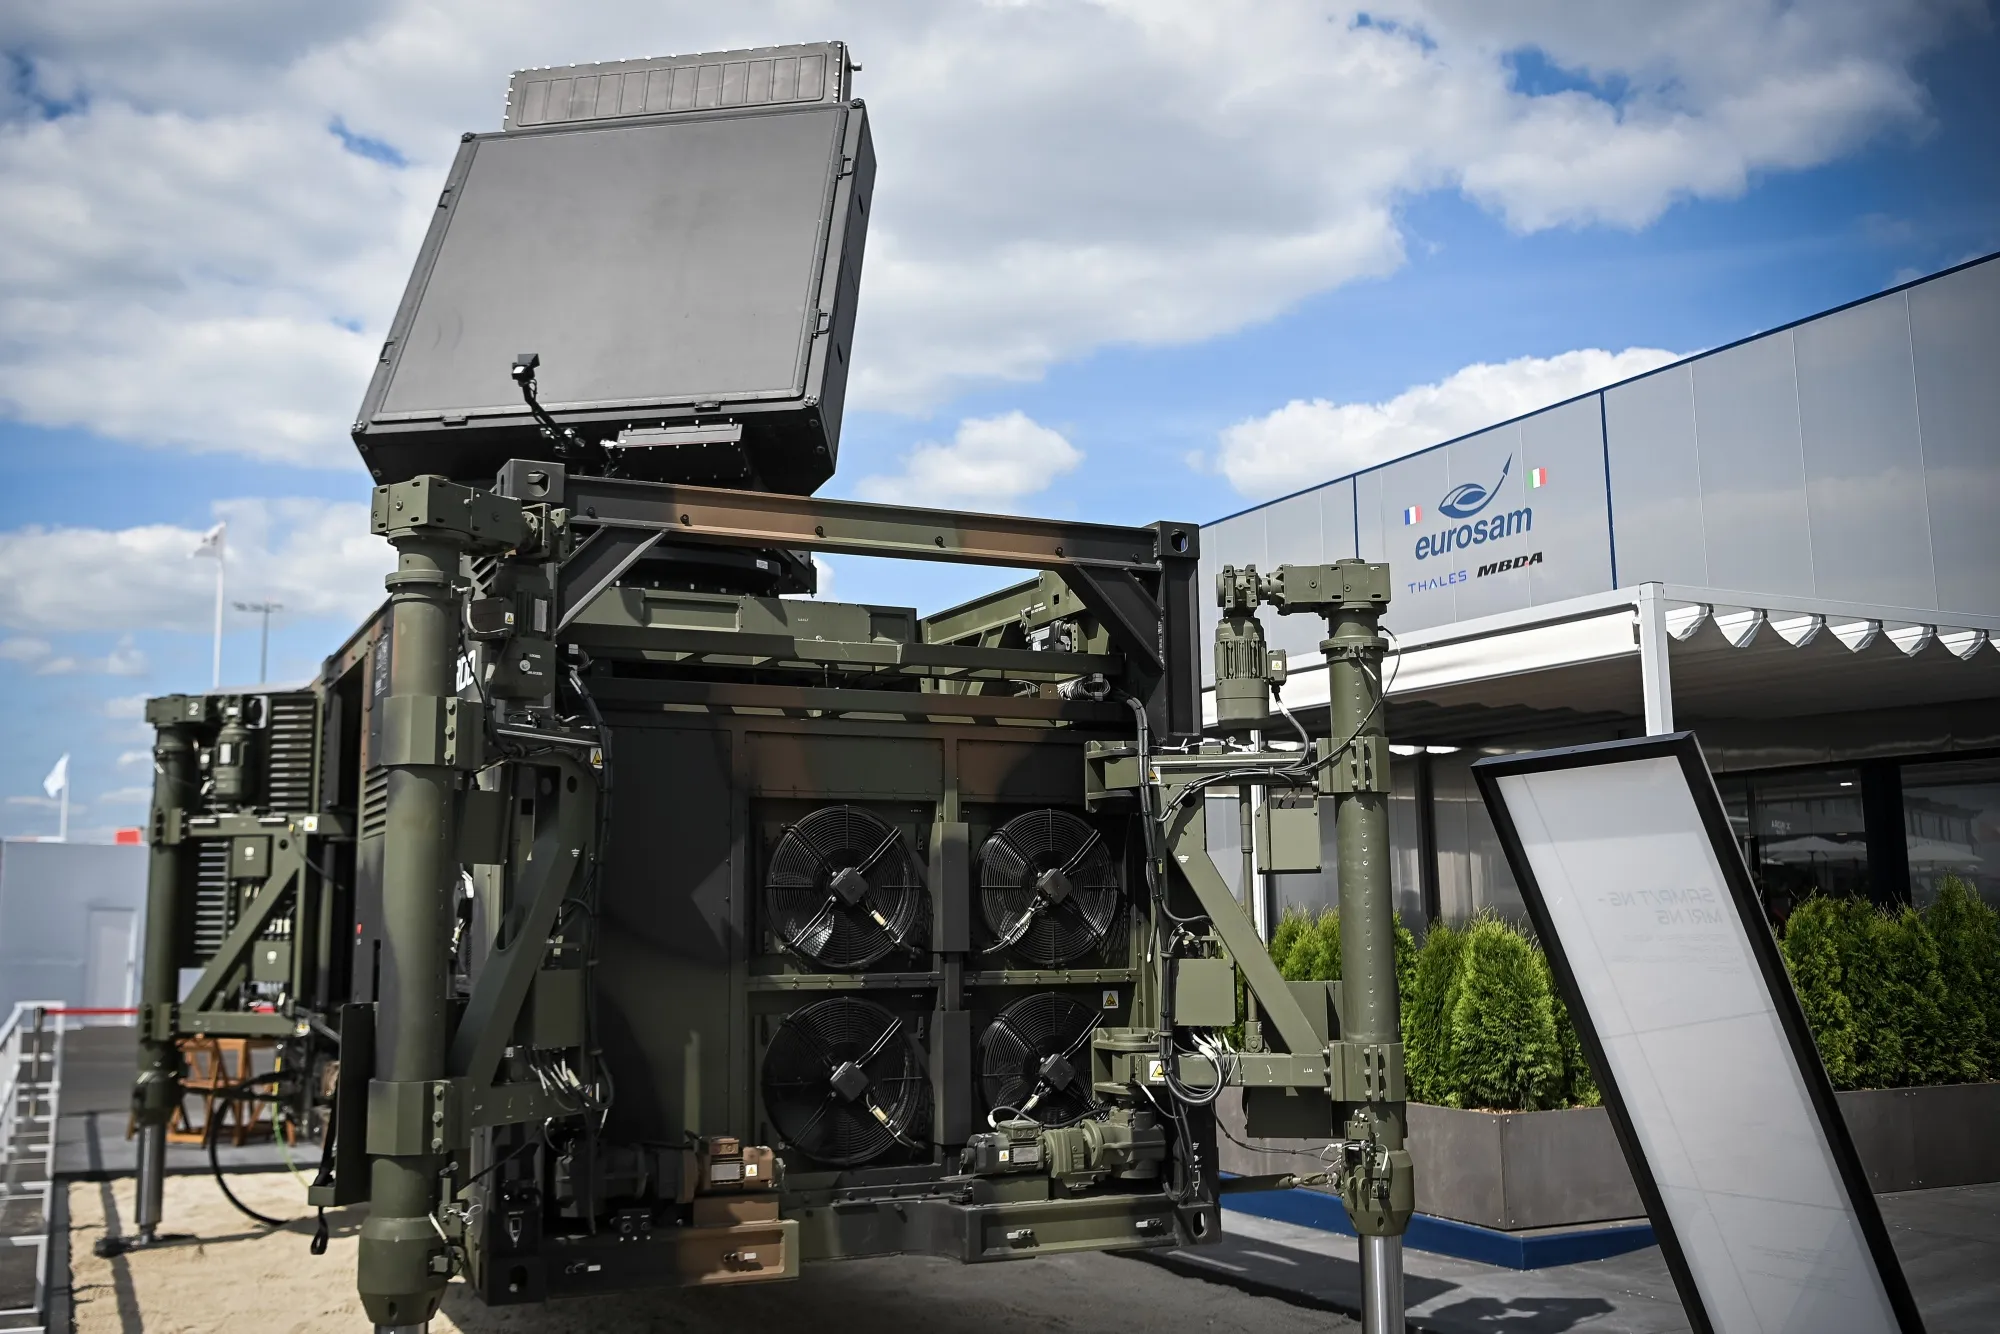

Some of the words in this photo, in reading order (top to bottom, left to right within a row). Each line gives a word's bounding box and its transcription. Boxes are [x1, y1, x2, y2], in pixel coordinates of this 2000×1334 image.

[1415, 507, 1532, 560] eurosam
[1477, 552, 1543, 578] MBDA
[1408, 570, 1467, 593] THALES
[188, 702, 199, 715] 2
